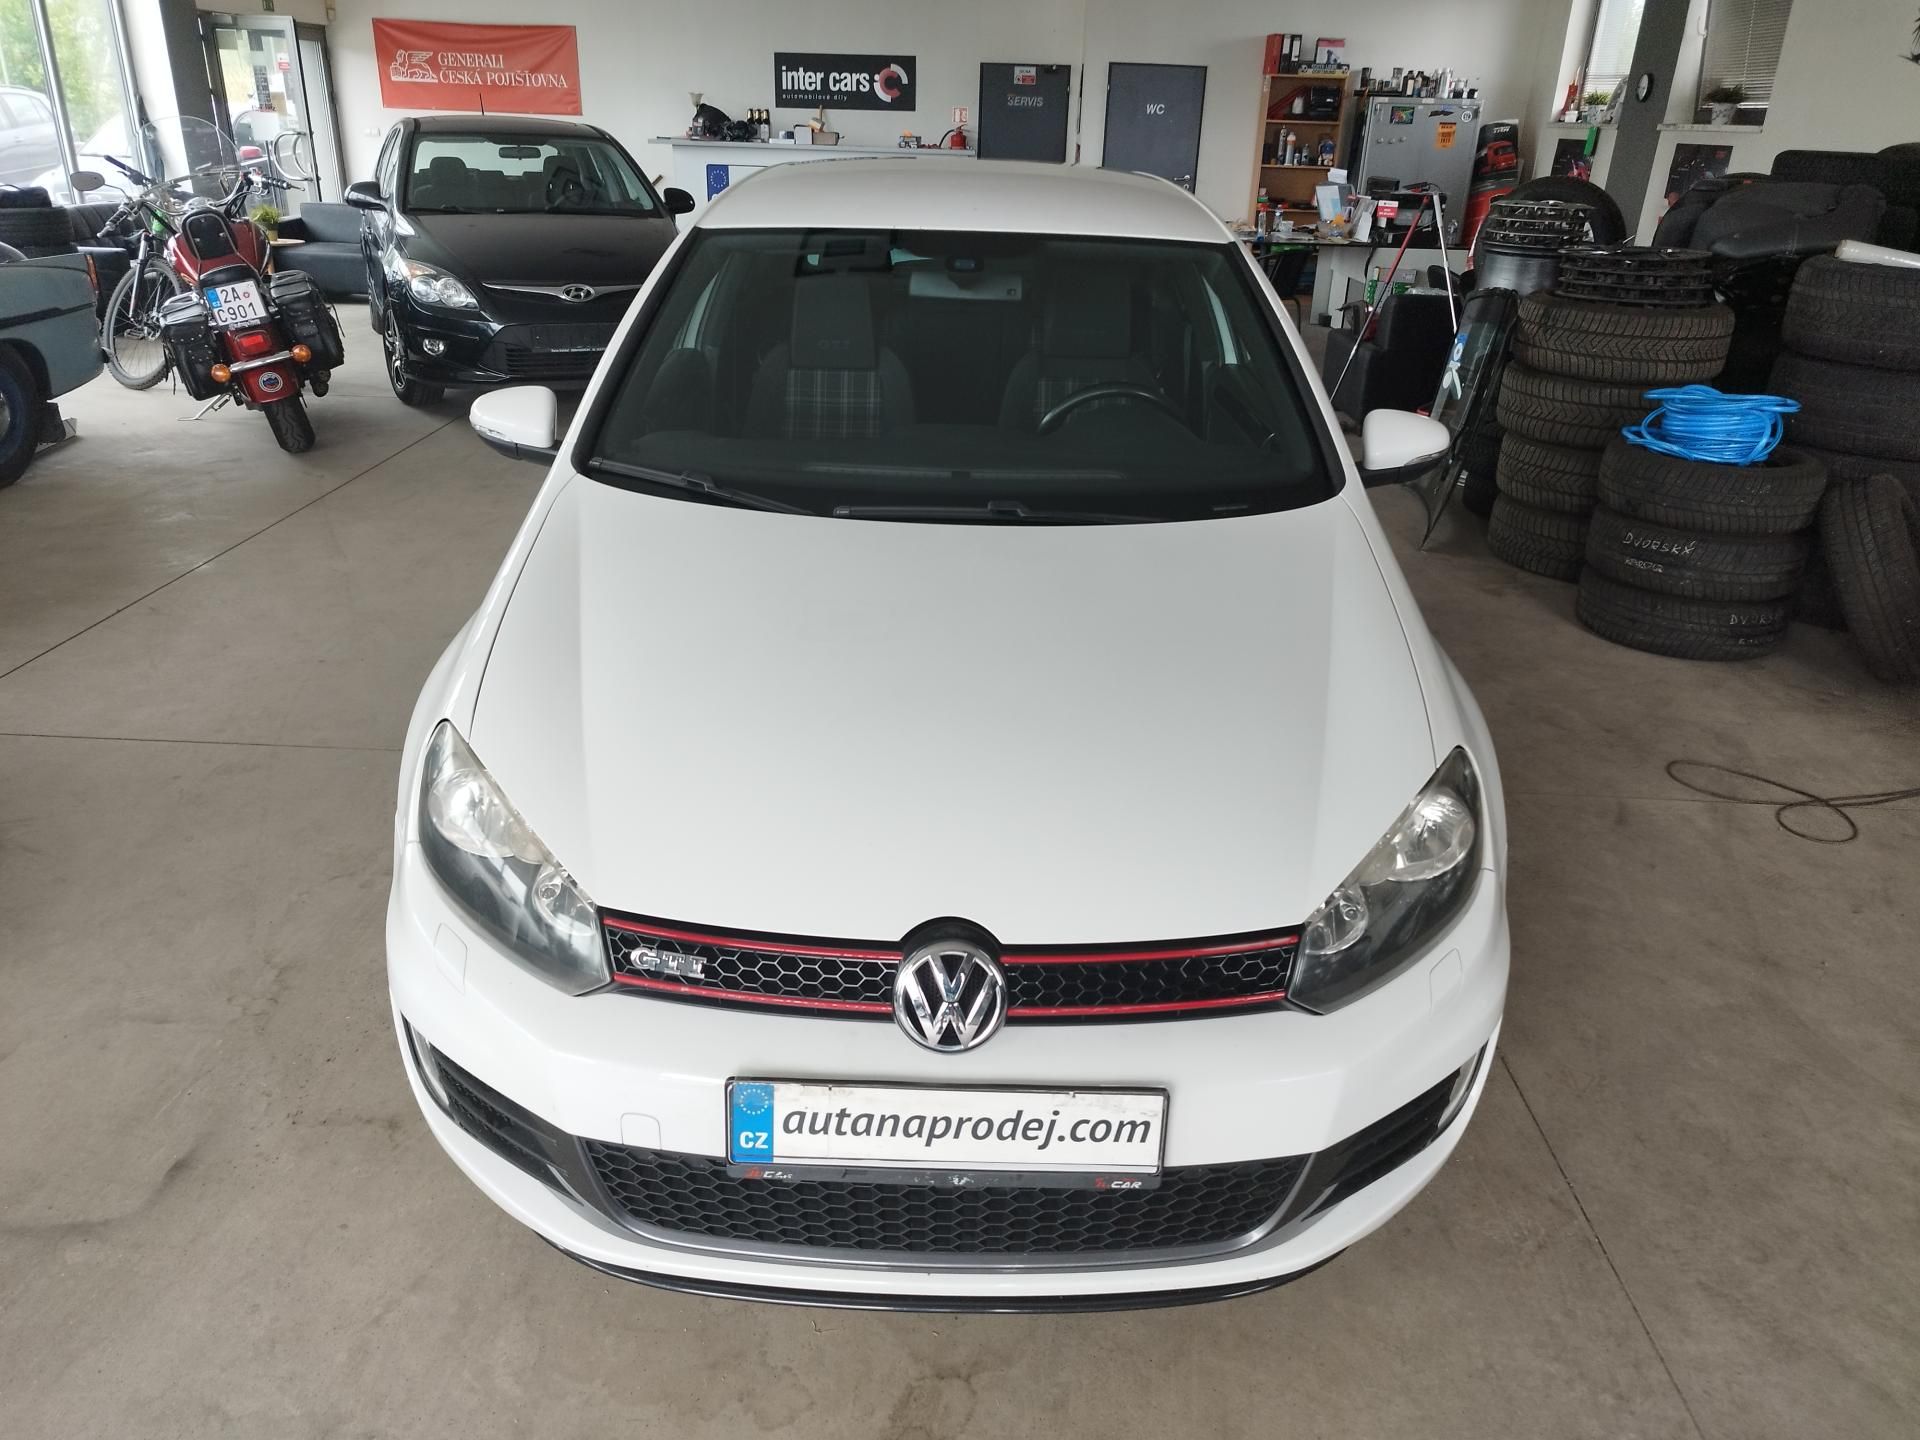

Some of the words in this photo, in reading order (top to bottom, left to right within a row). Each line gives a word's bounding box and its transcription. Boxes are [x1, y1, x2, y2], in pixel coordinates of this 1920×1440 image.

[437, 51, 504, 68] GENERALI
[439, 68, 483, 85] ČESKÁ
[487, 70, 568, 89] POJIŠŤOVNA
[781, 65, 825, 91] inter
[828, 71, 871, 92] cars
[1007, 95, 1044, 107] SERVIS
[1146, 103, 1165, 115] WC
[220, 287, 242, 303] 2A
[216, 302, 257, 323] C901
[630, 947, 707, 979] GTI
[739, 1131, 769, 1149] CZ
[782, 1106, 1152, 1151] autanaprodej.com
[1111, 1181, 1142, 1189] CAR
